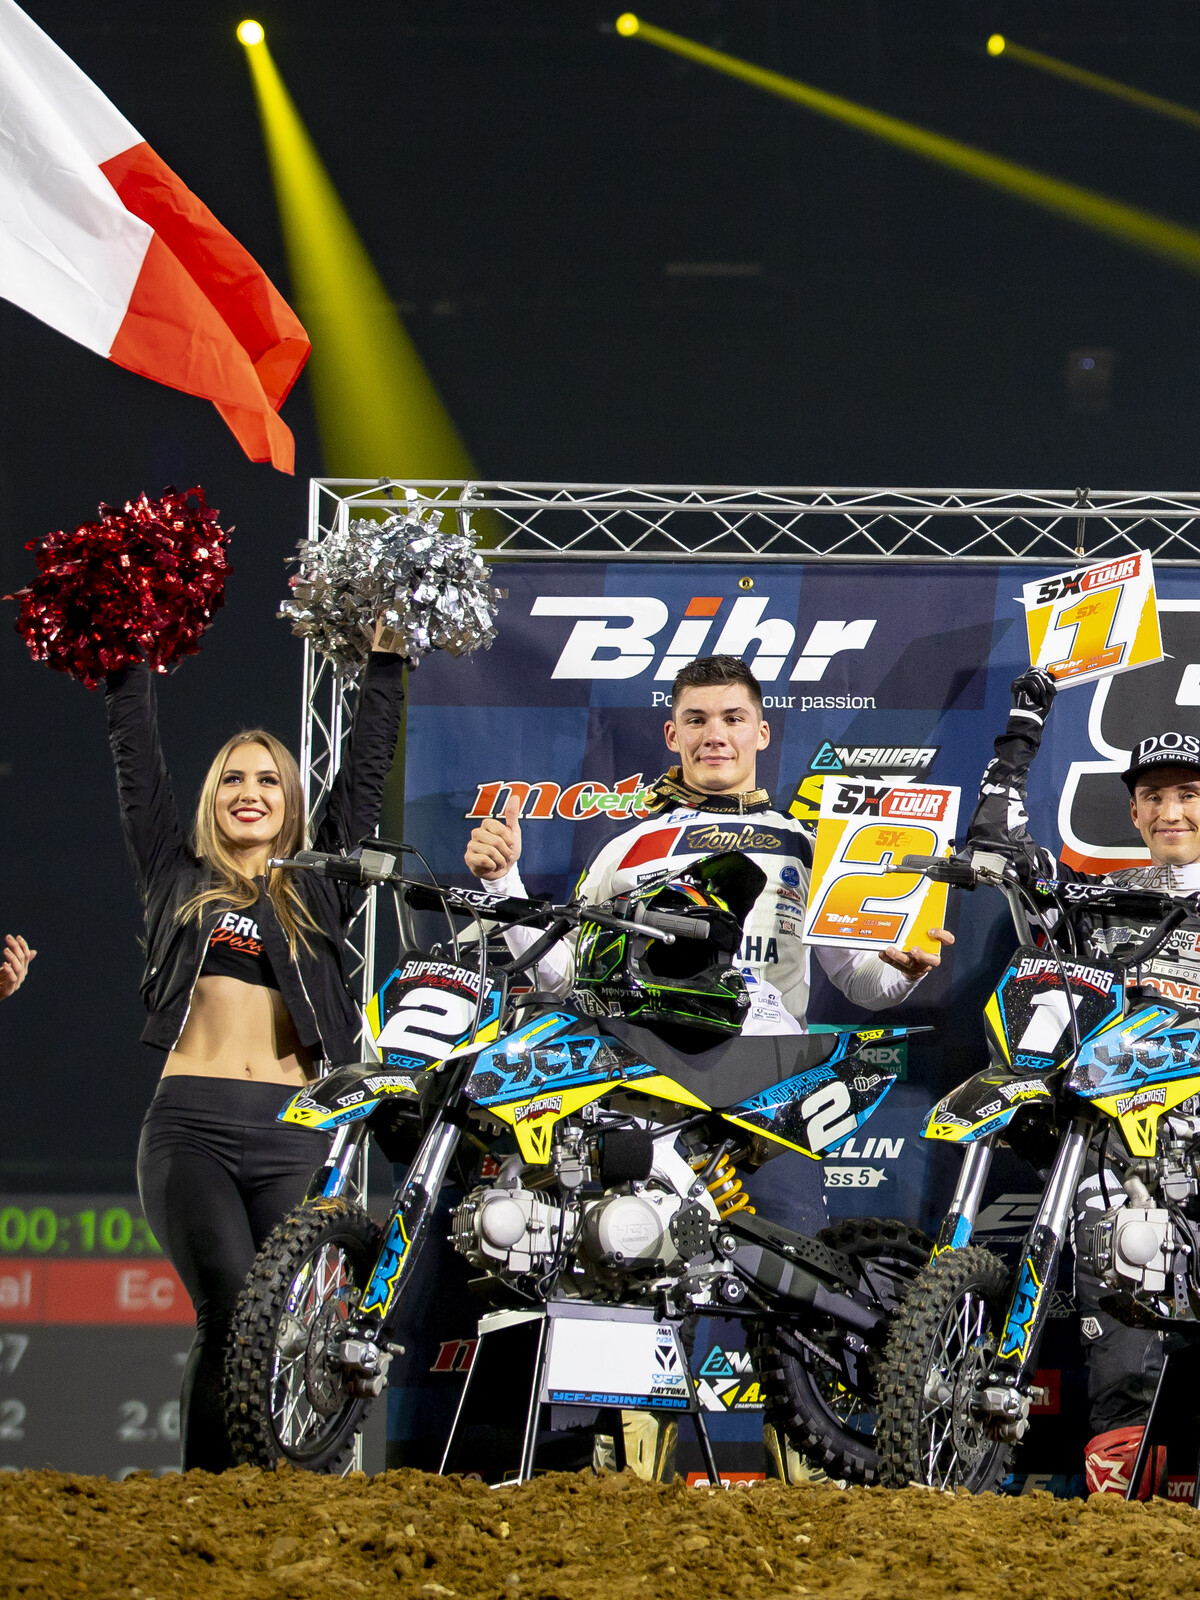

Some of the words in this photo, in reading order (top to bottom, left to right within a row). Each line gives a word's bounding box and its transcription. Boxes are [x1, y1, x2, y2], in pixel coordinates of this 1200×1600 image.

[1036, 571, 1087, 605] SX
[1088, 560, 1136, 584] TOUR
[530, 596, 878, 681] Bihr
[1045, 583, 1127, 682] 1
[801, 693, 877, 711] passion
[1138, 732, 1200, 758] DOS
[832, 783, 892, 817] SX
[888, 791, 944, 815] TOUR
[807, 822, 939, 944] 2
[400, 960, 495, 999] SUPERCROSS
[1016, 957, 1115, 994] SUPERCROSS
[375, 986, 478, 1062] 2
[1016, 989, 1084, 1054] 1
[333, 1106, 367, 1125] 2021
[513, 1095, 563, 1121] SUPERCROSS
[801, 1080, 858, 1155] 2
[1115, 1087, 1167, 1115] SUPERCROSS
[0, 1206, 163, 1252] 00:10:
[552, 1392, 688, 1408] YCF-RIDING.COM
[650, 1386, 687, 1396] DAYTONA
